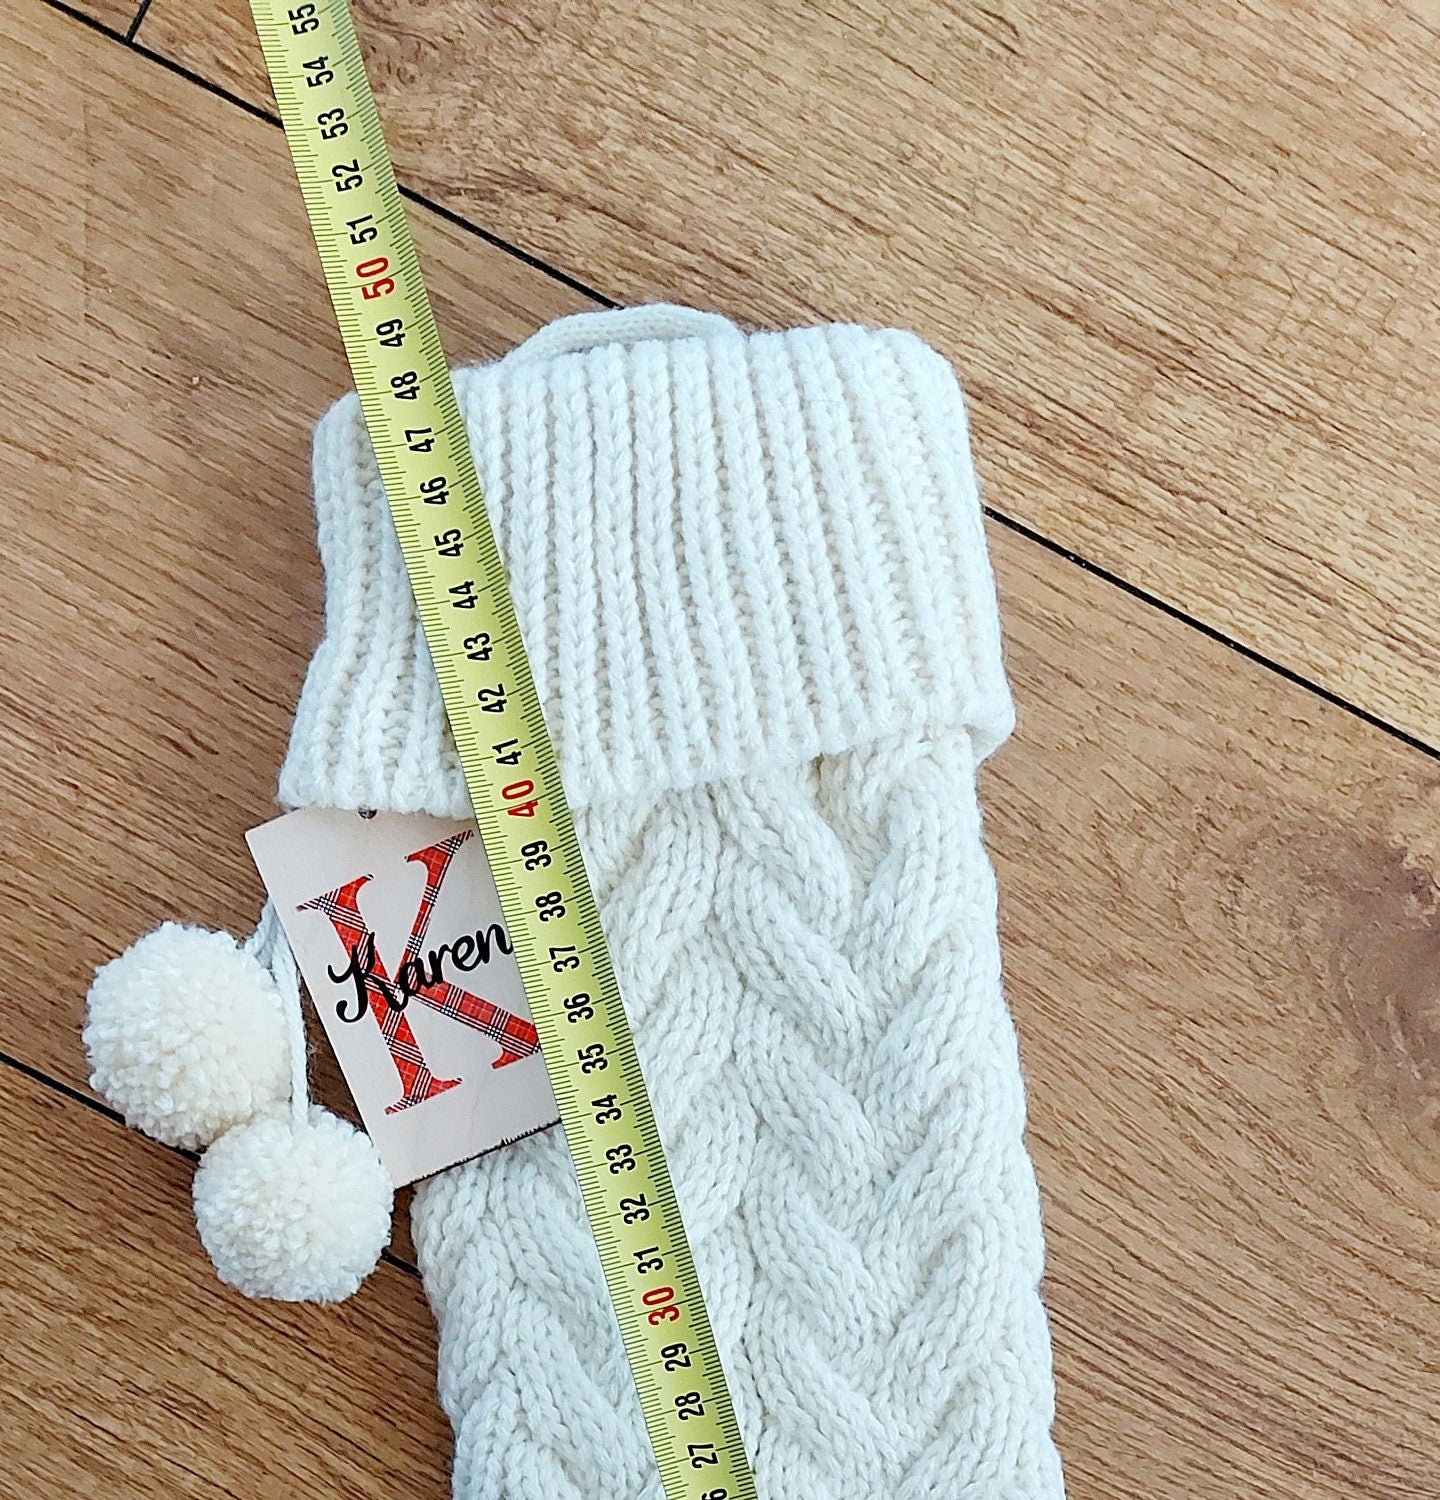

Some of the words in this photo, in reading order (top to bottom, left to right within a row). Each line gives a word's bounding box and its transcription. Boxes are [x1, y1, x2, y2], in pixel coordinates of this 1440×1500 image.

[288, 2, 320, 35] 55
[302, 55, 334, 87] 54
[317, 107, 349, 139] 53
[332, 159, 364, 192] 52
[346, 214, 378, 245] 51
[355, 256, 395, 300] 50
[375, 318, 406, 348] 49
[390, 371, 420, 400] 48
[404, 427, 435, 453] 47
[419, 476, 449, 506] 46
[434, 528, 464, 557] 45
[448, 580, 478, 609] 44
[463, 632, 493, 661] 43
[477, 683, 507, 713] 42
[491, 738, 522, 766] 41
[501, 779, 539, 819] 40
[520, 839, 552, 871] 39
[535, 891, 566, 922] 38
[296, 829, 541, 1115] K
[327, 922, 513, 1024] Karen
[549, 944, 580, 973] 37
[563, 992, 594, 1023] 36
[577, 1043, 609, 1074] 35
[590, 1094, 623, 1124] 34
[605, 1143, 636, 1174] 33
[619, 1193, 650, 1225] 32
[633, 1246, 665, 1275] 31
[641, 1286, 680, 1326] 30
[660, 1342, 691, 1372] 29
[674, 1391, 705, 1421] 28
[687, 1442, 719, 1469] 27
